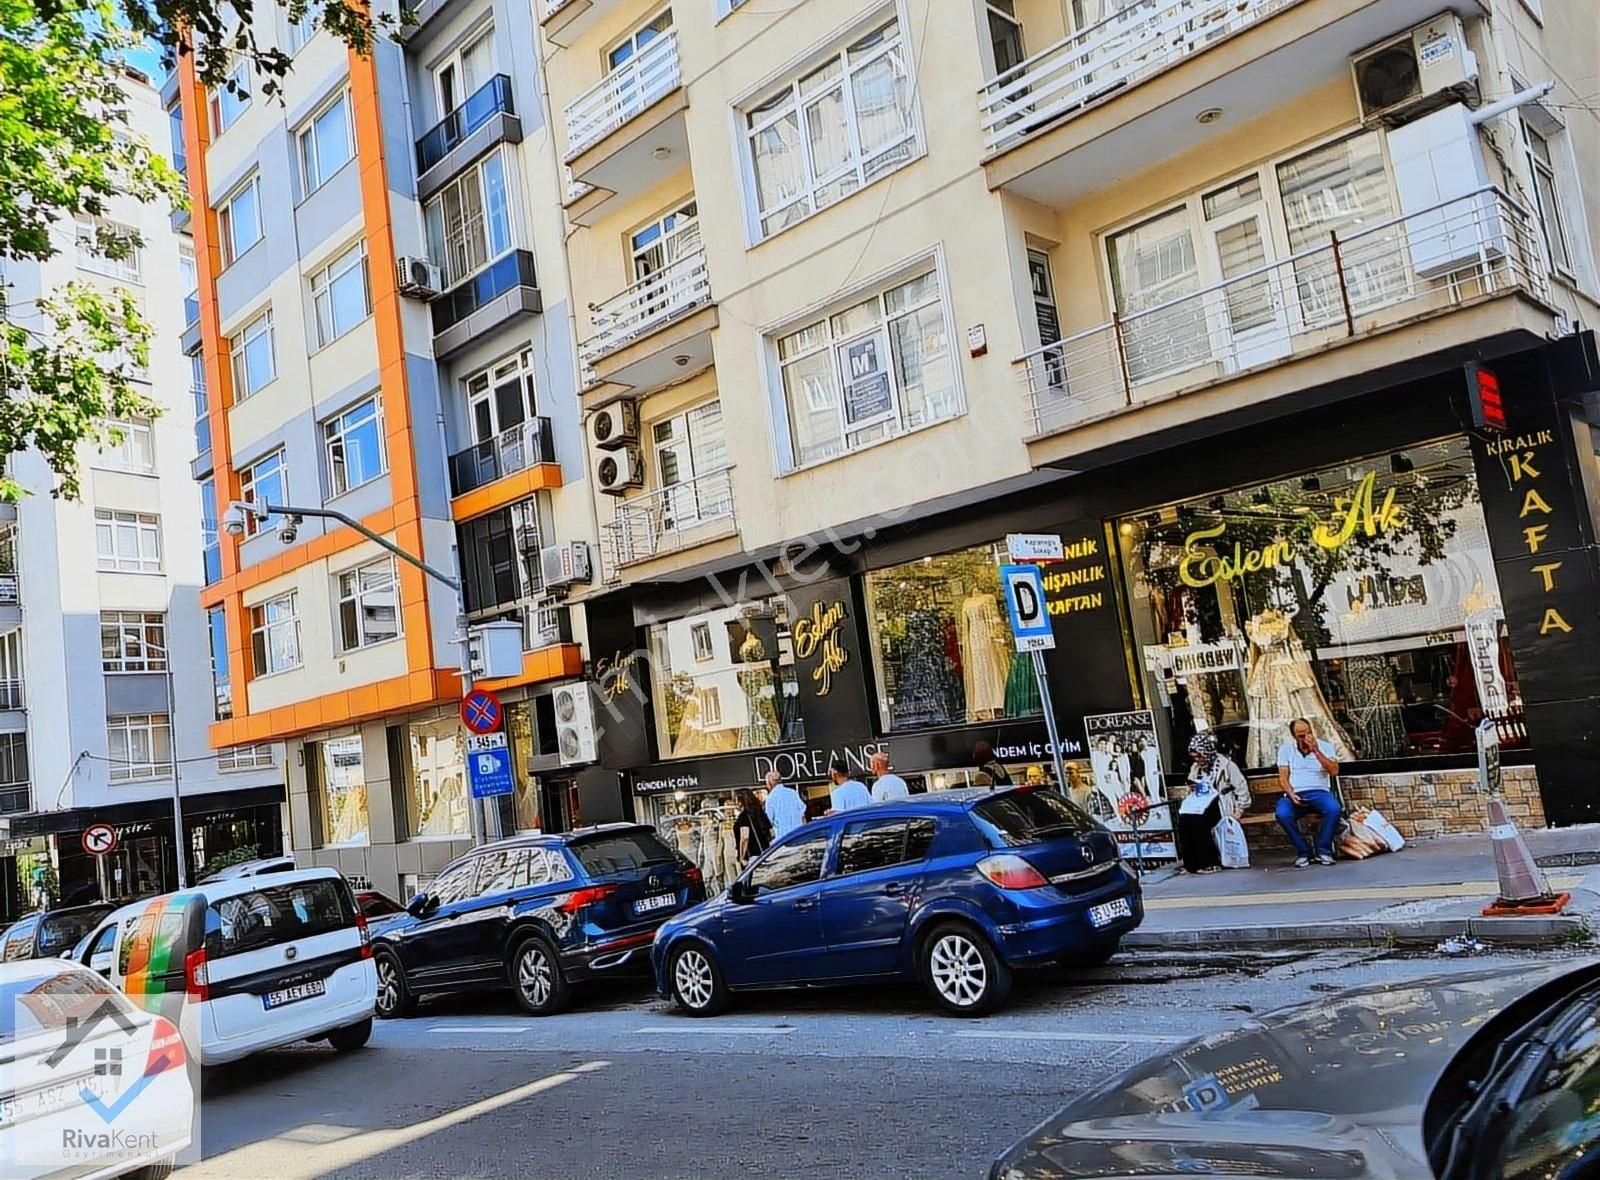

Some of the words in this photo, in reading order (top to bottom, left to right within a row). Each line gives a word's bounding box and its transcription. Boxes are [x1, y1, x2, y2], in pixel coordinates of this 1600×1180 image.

[1486, 429, 1553, 456] KIRALIK
[1179, 523, 1296, 588] Eslem
[1311, 470, 1408, 549] Ak
[1013, 581, 1039, 621] D
[1046, 592, 1102, 616] KAFTAN
[795, 601, 846, 658] Eslem
[813, 627, 848, 695] Ak
[1089, 711, 1151, 730] DOREANSE
[1028, 741, 1042, 758] İÇ
[270, 993, 282, 1005] 55
